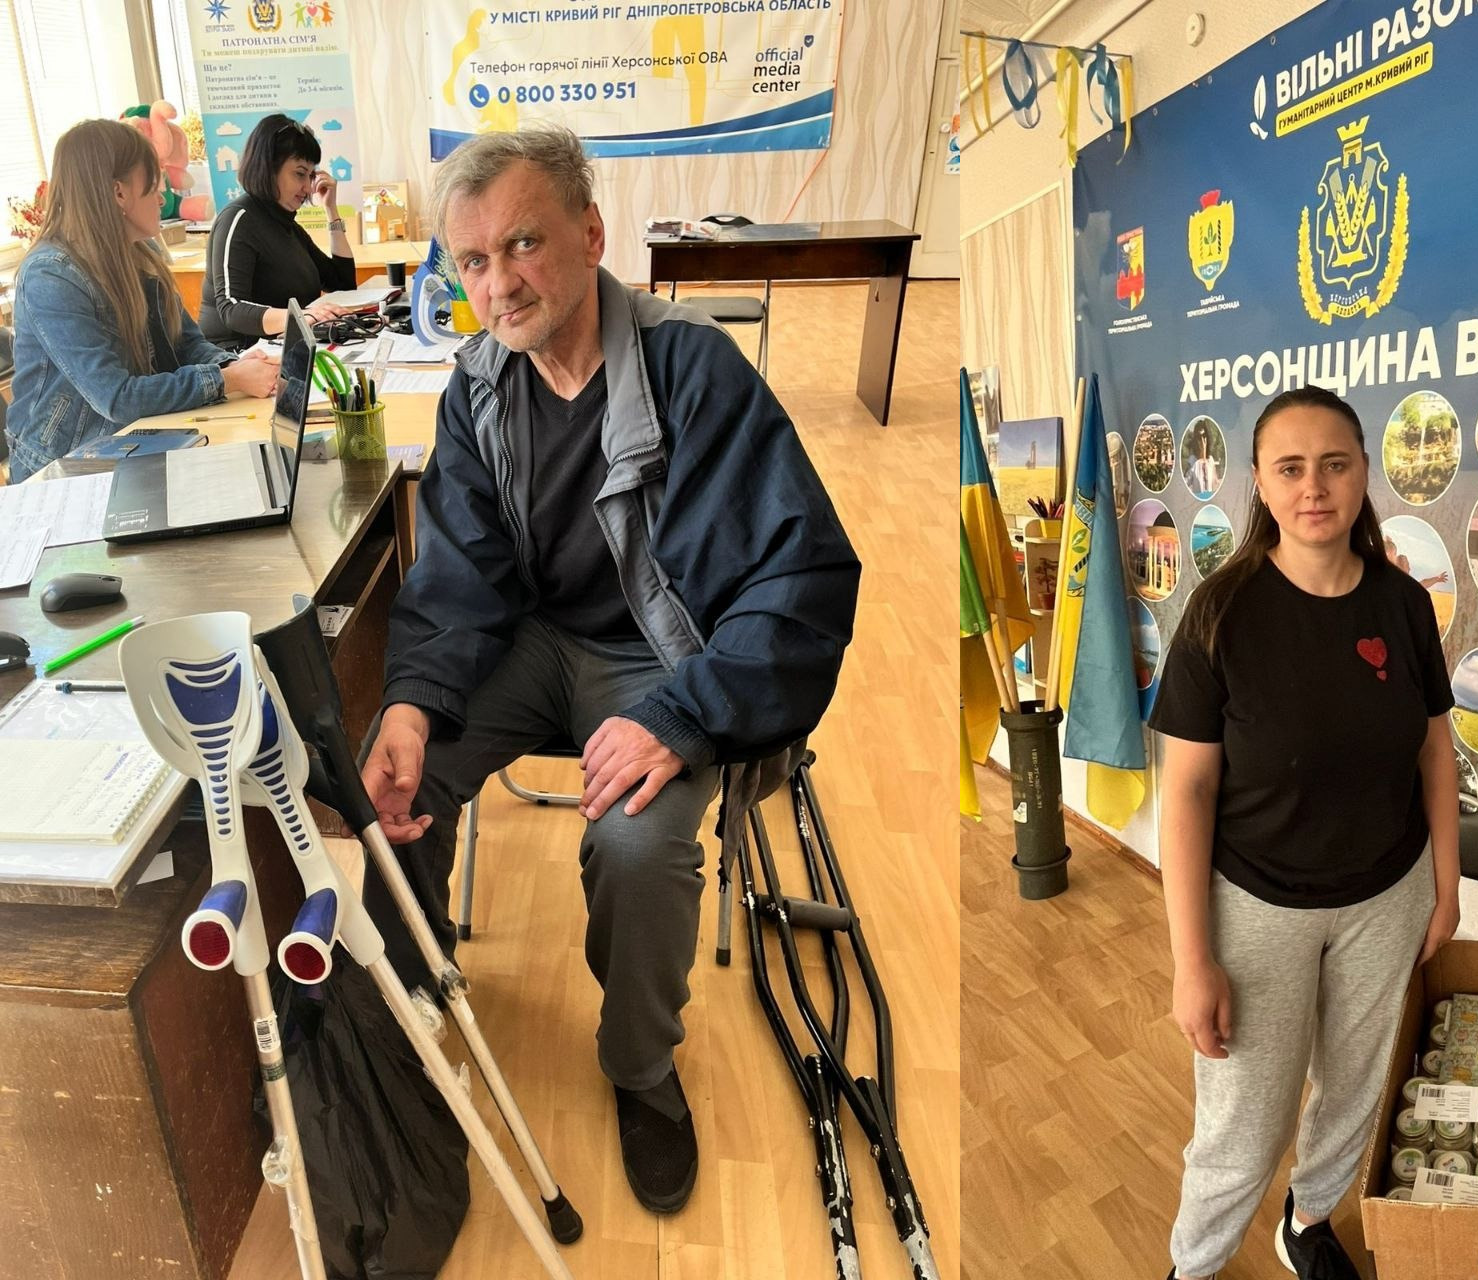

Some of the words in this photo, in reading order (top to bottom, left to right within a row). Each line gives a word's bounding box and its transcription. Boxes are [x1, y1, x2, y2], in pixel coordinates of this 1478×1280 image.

[490, 13, 498, 24] У
[502, 12, 540, 24] МІСТІ
[546, 6, 598, 22] КРИВИЙ
[603, 7, 622, 19] РІГ
[626, 1, 764, 20] ДНІПРОПЕТРОВСЬКА
[769, 0, 831, 11] ОБЛАСТЬ
[222, 36, 287, 47] ПАТРОНАТНА
[470, 61, 525, 75] Телефон
[530, 58, 578, 73] гарячої
[581, 57, 609, 69] лінії
[612, 53, 696, 70] Херсонської
[698, 51, 728, 64] ОВА
[756, 47, 803, 62] official
[754, 61, 800, 77] media
[1275, 29, 1363, 108] ВІЛЬНІ
[498, 87, 510, 103] 0
[516, 85, 554, 103] 800
[560, 83, 597, 101] 330
[603, 81, 636, 99] 951
[752, 80, 801, 93] center
[1278, 93, 1335, 130] ГУМАНІТАРНИЙ
[1337, 81, 1363, 104] ЦЕНТР
[1365, 57, 1413, 90] М.КРИВИЙ
[1415, 50, 1430, 68] РІГ
[1179, 325, 1441, 403] ХЕРСОНЩИНА
